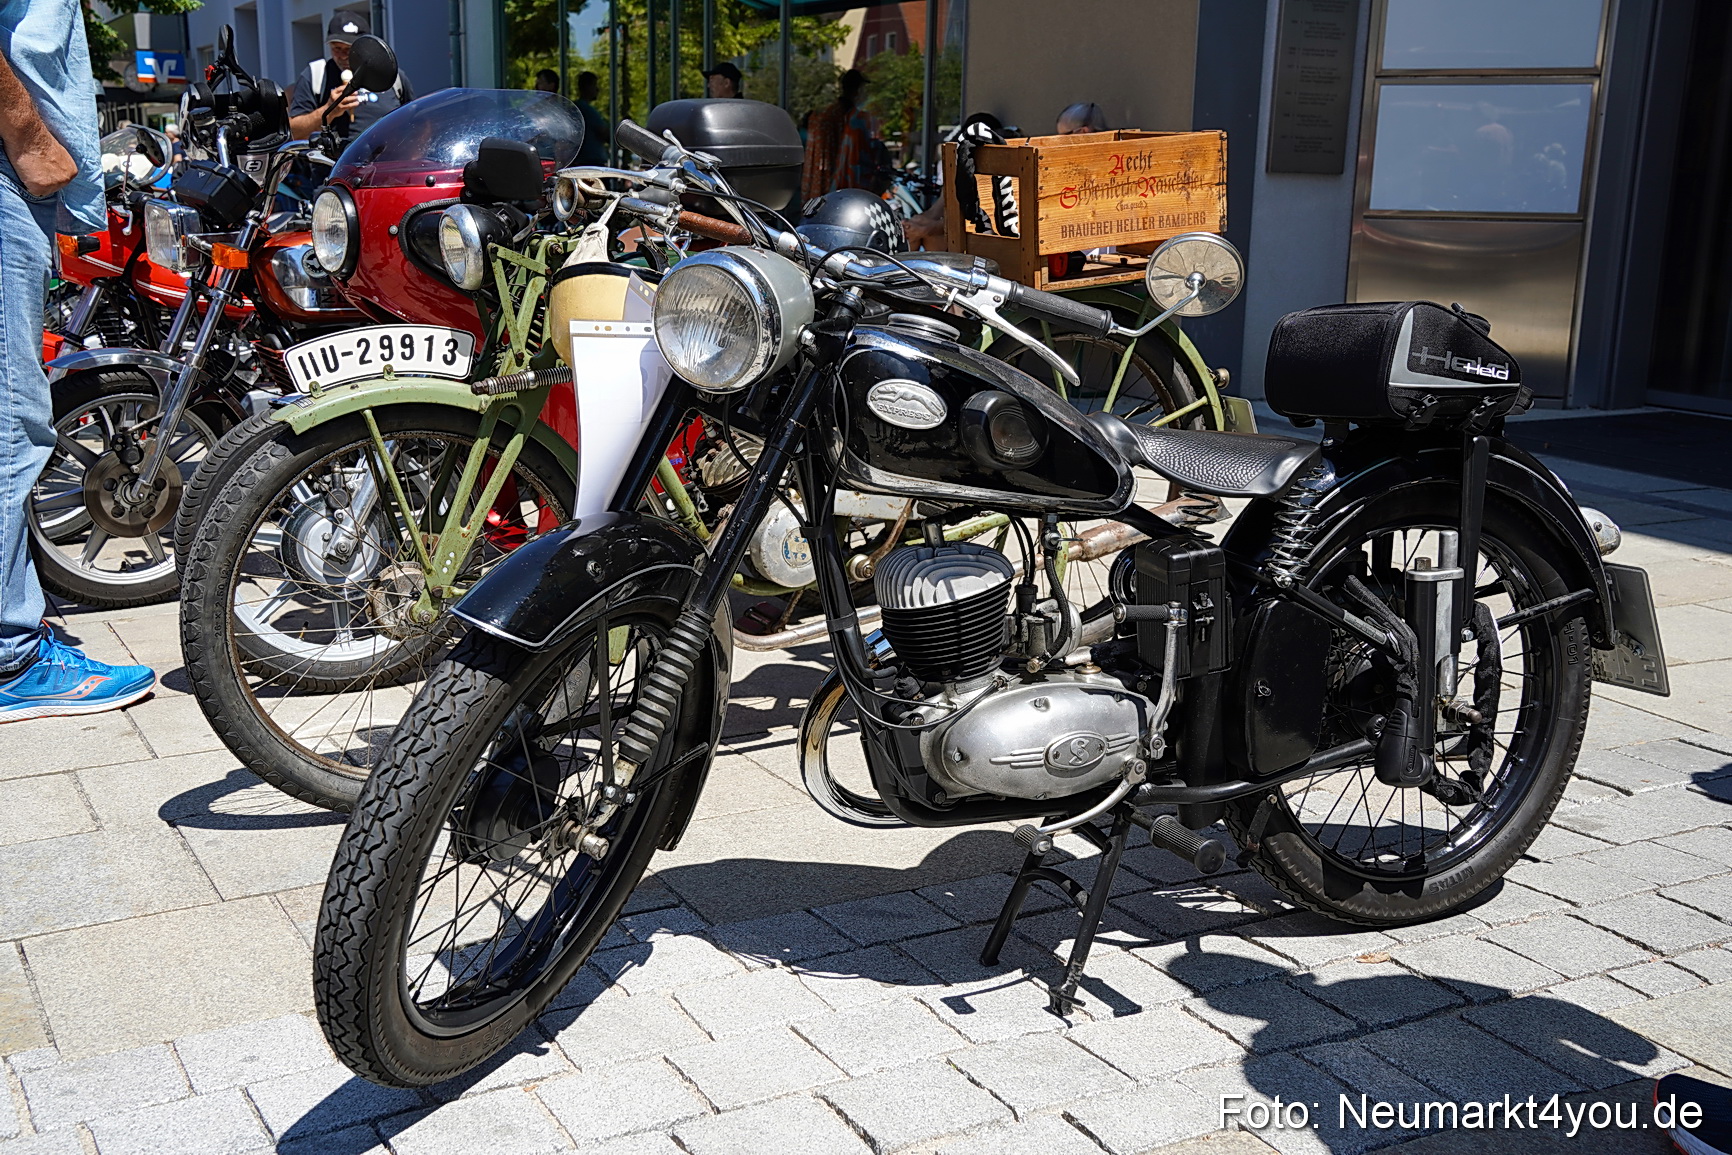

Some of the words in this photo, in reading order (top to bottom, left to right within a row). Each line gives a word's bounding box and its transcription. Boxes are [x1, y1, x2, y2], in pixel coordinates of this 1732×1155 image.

[1109, 150, 1153, 175] Aecht
[1061, 220, 1112, 239] BRAUEREI
[1116, 216, 1155, 234] HELLER
[1158, 211, 1206, 229] BAMBERG
[1463, 362, 1509, 380] Held
[877, 403, 931, 421] EXPRESS
[1428, 866, 1475, 894] MITAS
